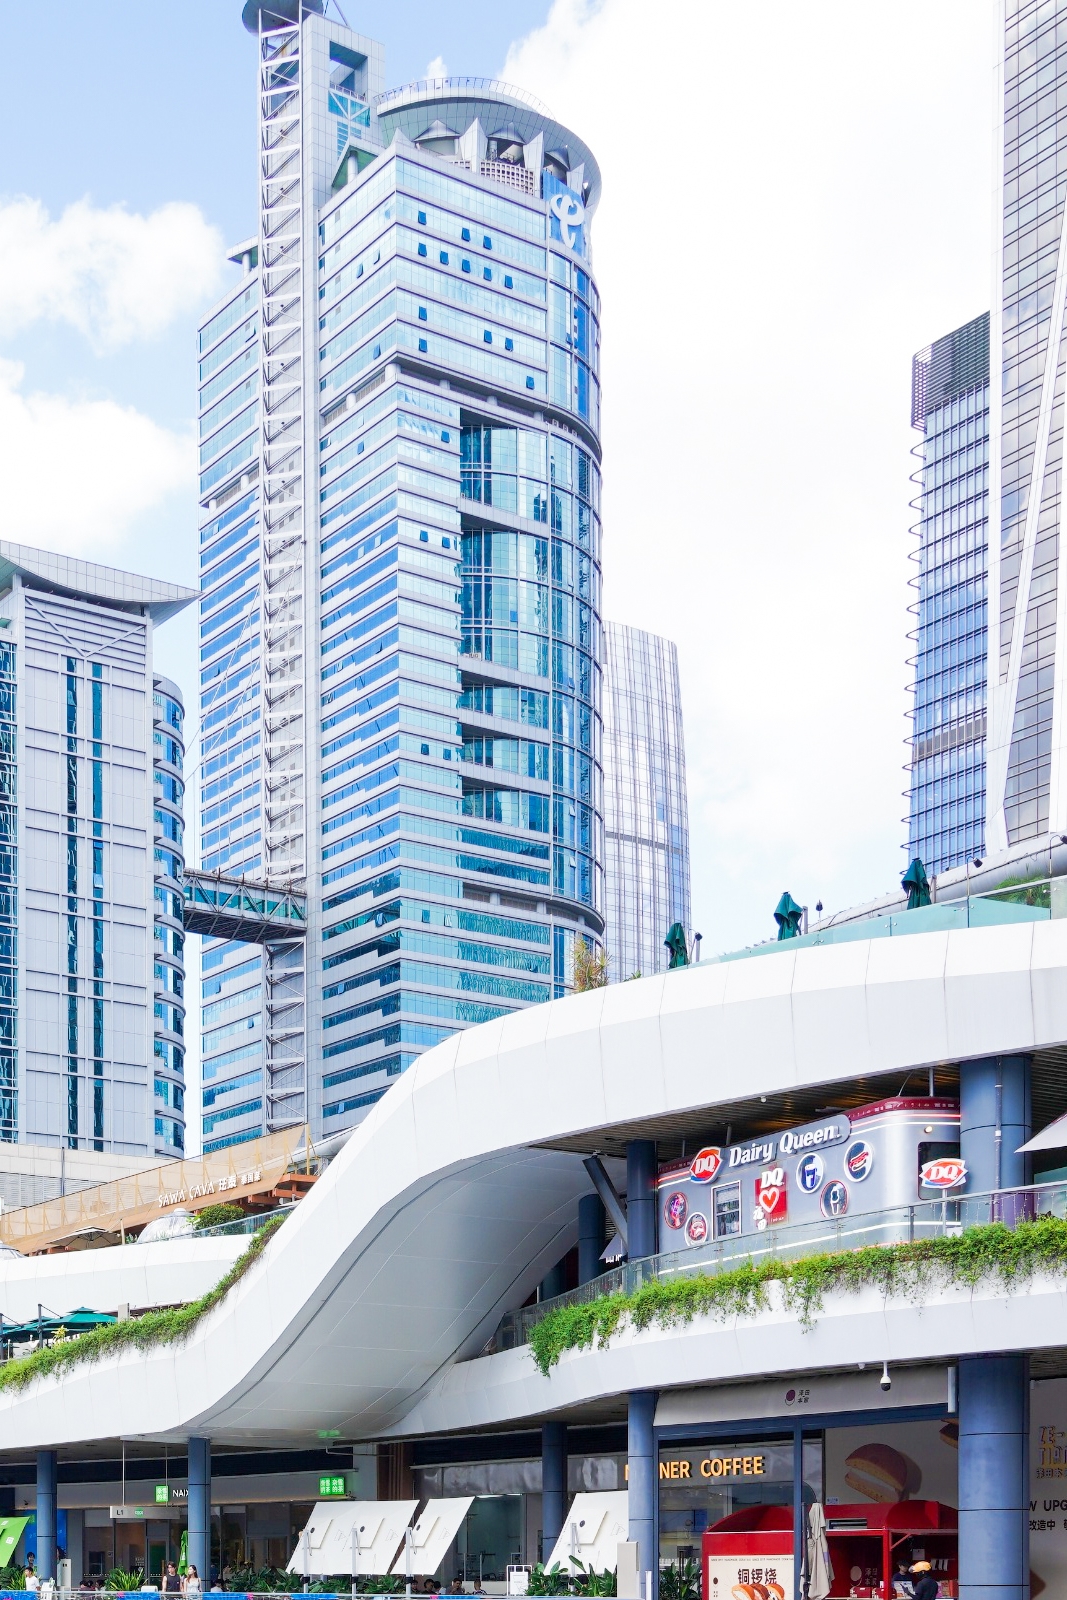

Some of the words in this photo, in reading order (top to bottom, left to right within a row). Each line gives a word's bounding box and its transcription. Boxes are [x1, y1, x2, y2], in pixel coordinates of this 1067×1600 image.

[729, 1142, 773, 1168] Dairy
[779, 1124, 834, 1152] Queen
[695, 1153, 721, 1176] DQ
[929, 1165, 958, 1182] DQ
[761, 1167, 785, 1189] DQ
[700, 1456, 764, 1477] COFFEE
